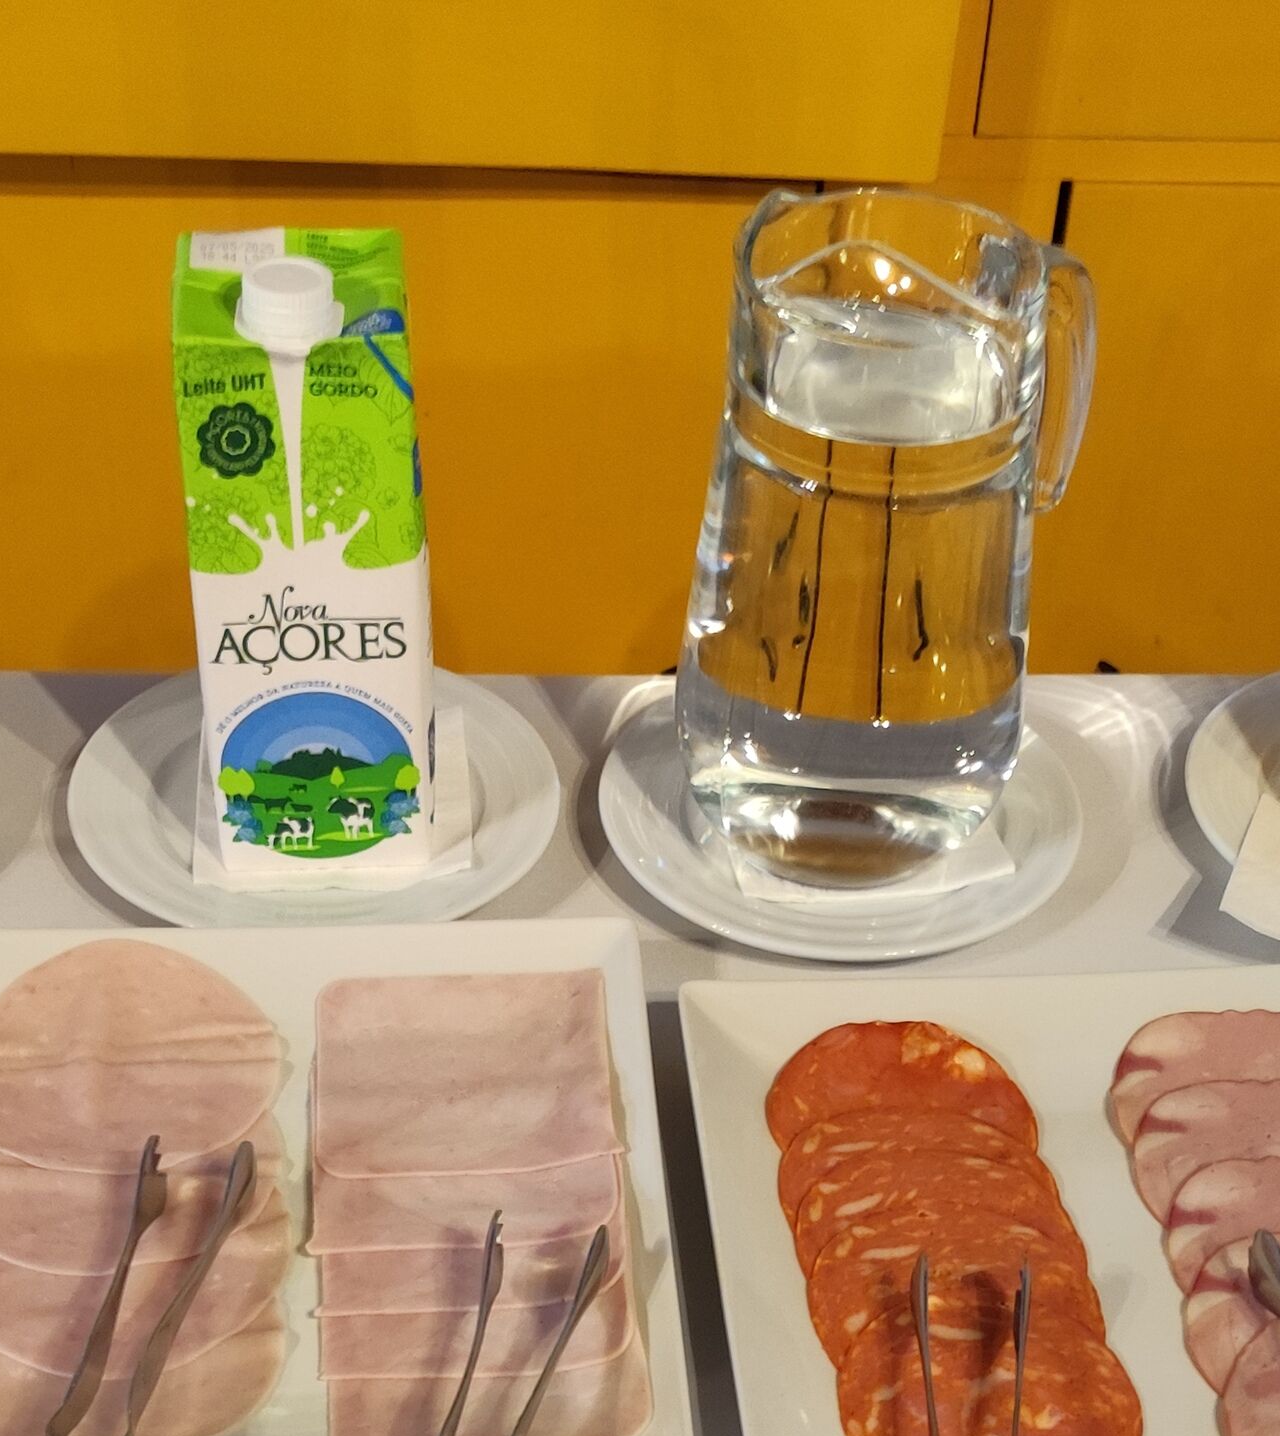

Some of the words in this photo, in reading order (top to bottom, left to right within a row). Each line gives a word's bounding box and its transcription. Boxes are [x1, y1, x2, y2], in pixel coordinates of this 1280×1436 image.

[309, 364, 357, 378] MEIO
[183, 375, 225, 398] Leite
[231, 373, 266, 392] UHT
[310, 382, 378, 398] GORDO
[249, 585, 329, 626] Nova
[209, 621, 407, 675] AÇORES
